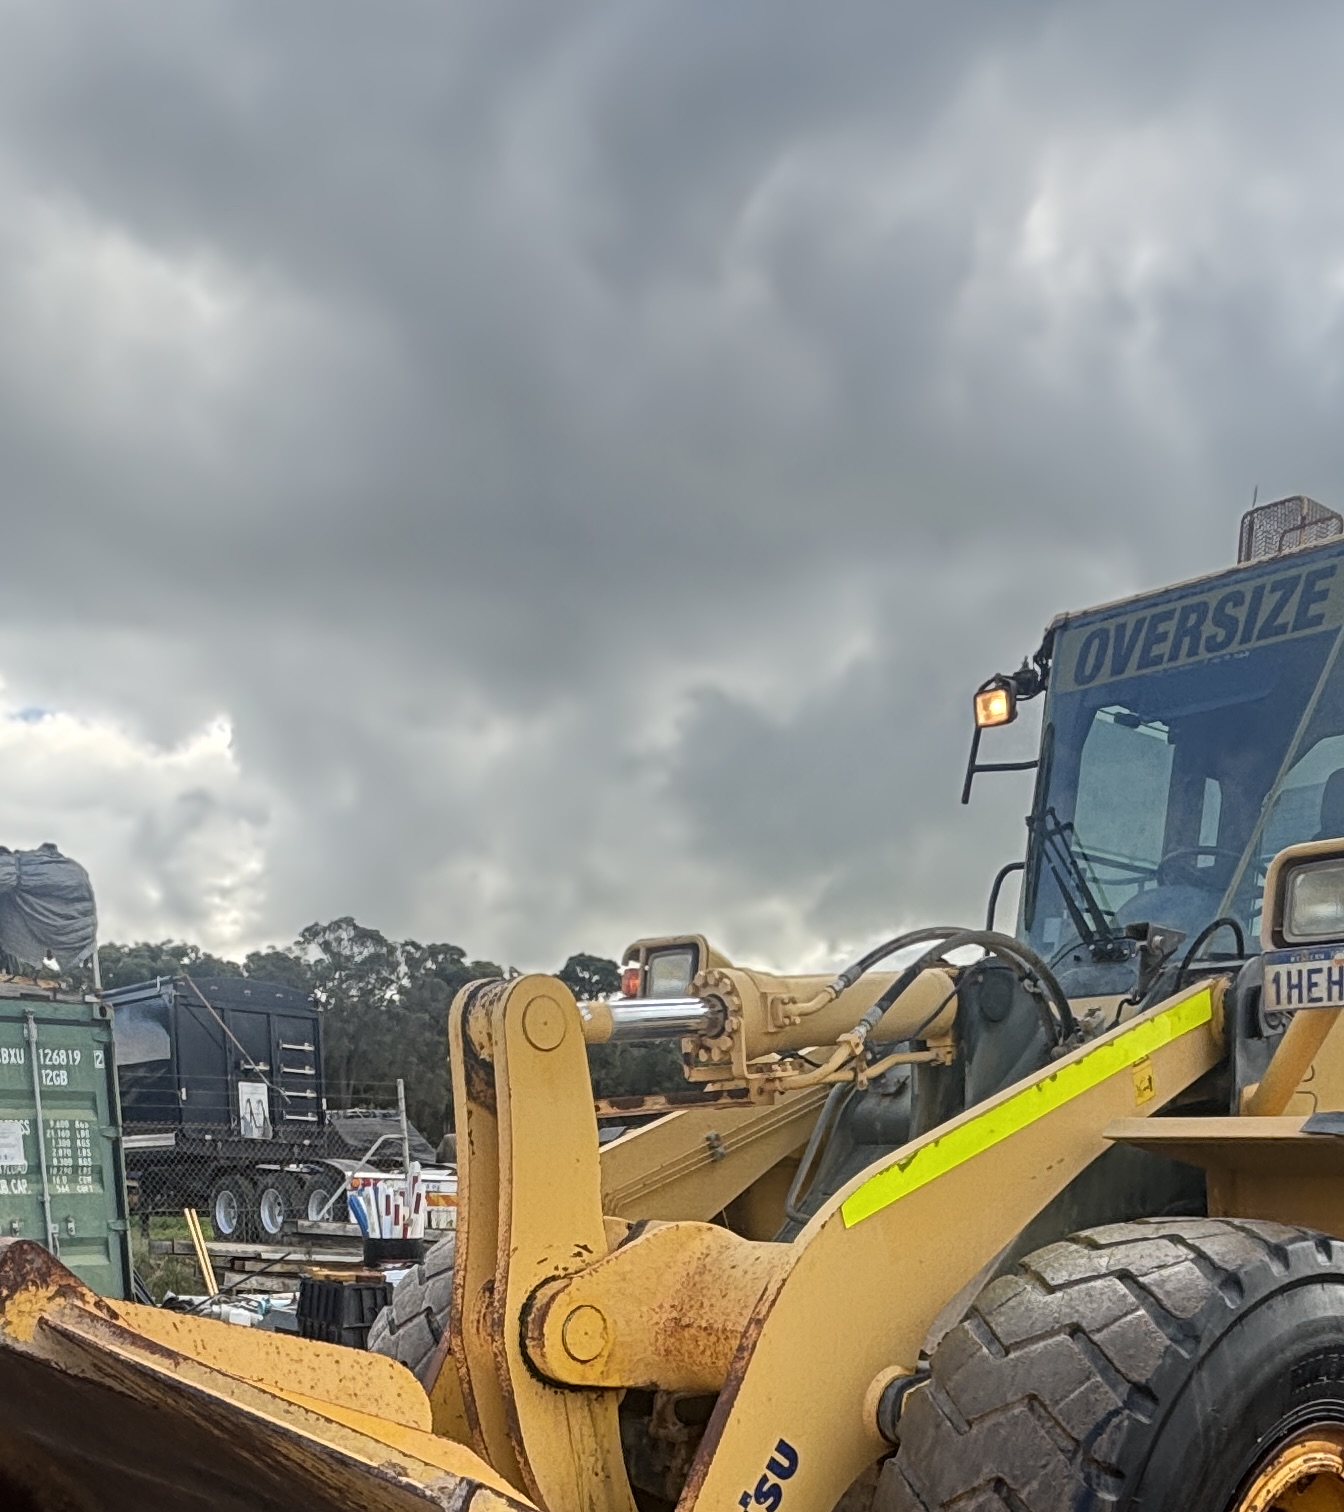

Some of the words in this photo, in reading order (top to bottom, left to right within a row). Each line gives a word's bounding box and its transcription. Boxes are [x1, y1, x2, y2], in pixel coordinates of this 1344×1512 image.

[1073, 564, 1338, 687] OVERSIZE
[39, 1048, 81, 1066] 126819
[95, 1051, 103, 1067] 2
